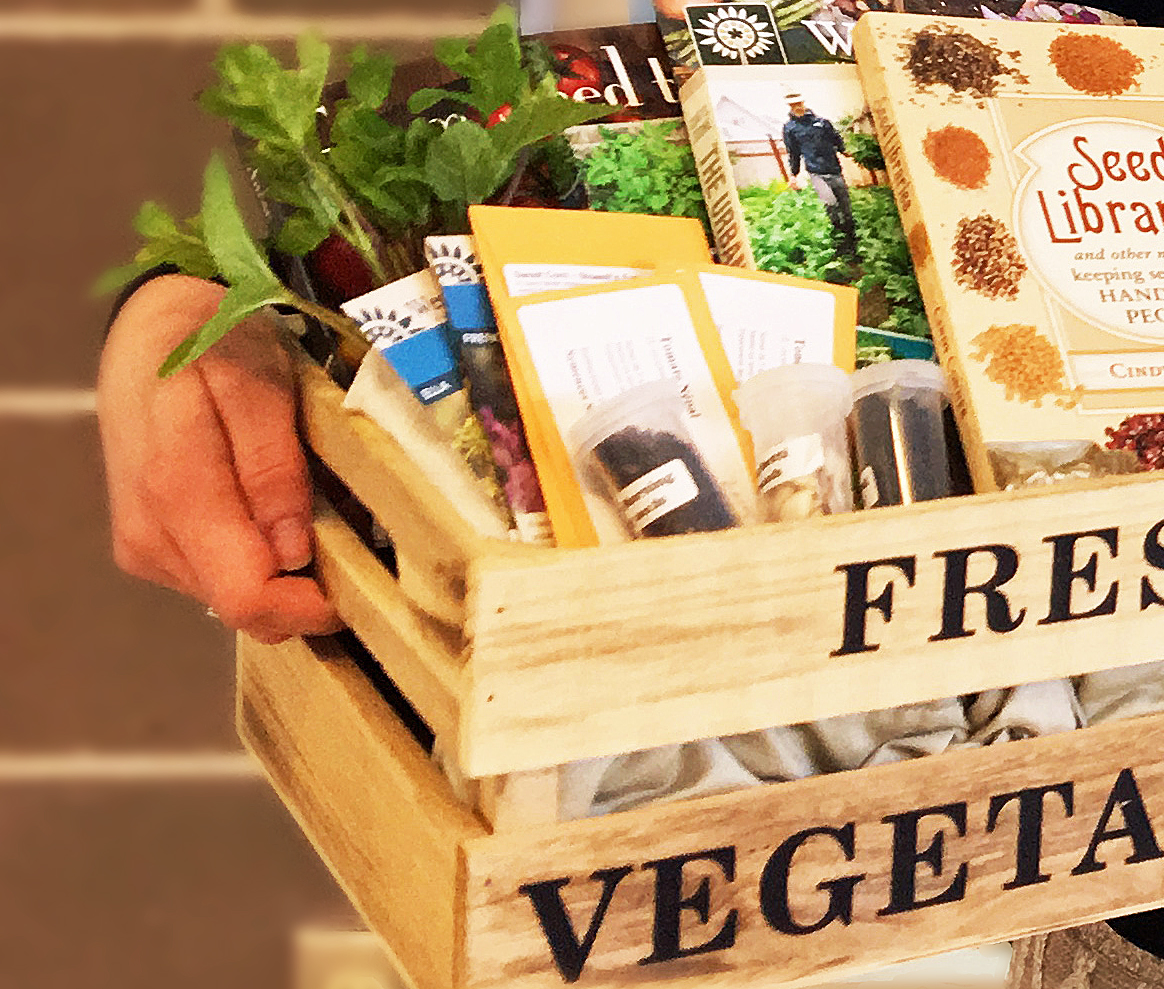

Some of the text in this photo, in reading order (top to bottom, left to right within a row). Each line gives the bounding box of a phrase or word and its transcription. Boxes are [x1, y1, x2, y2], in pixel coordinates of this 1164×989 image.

[1074, 248, 1105, 261] and
[1111, 248, 1151, 261] other
[1071, 268, 1145, 285] keeping
